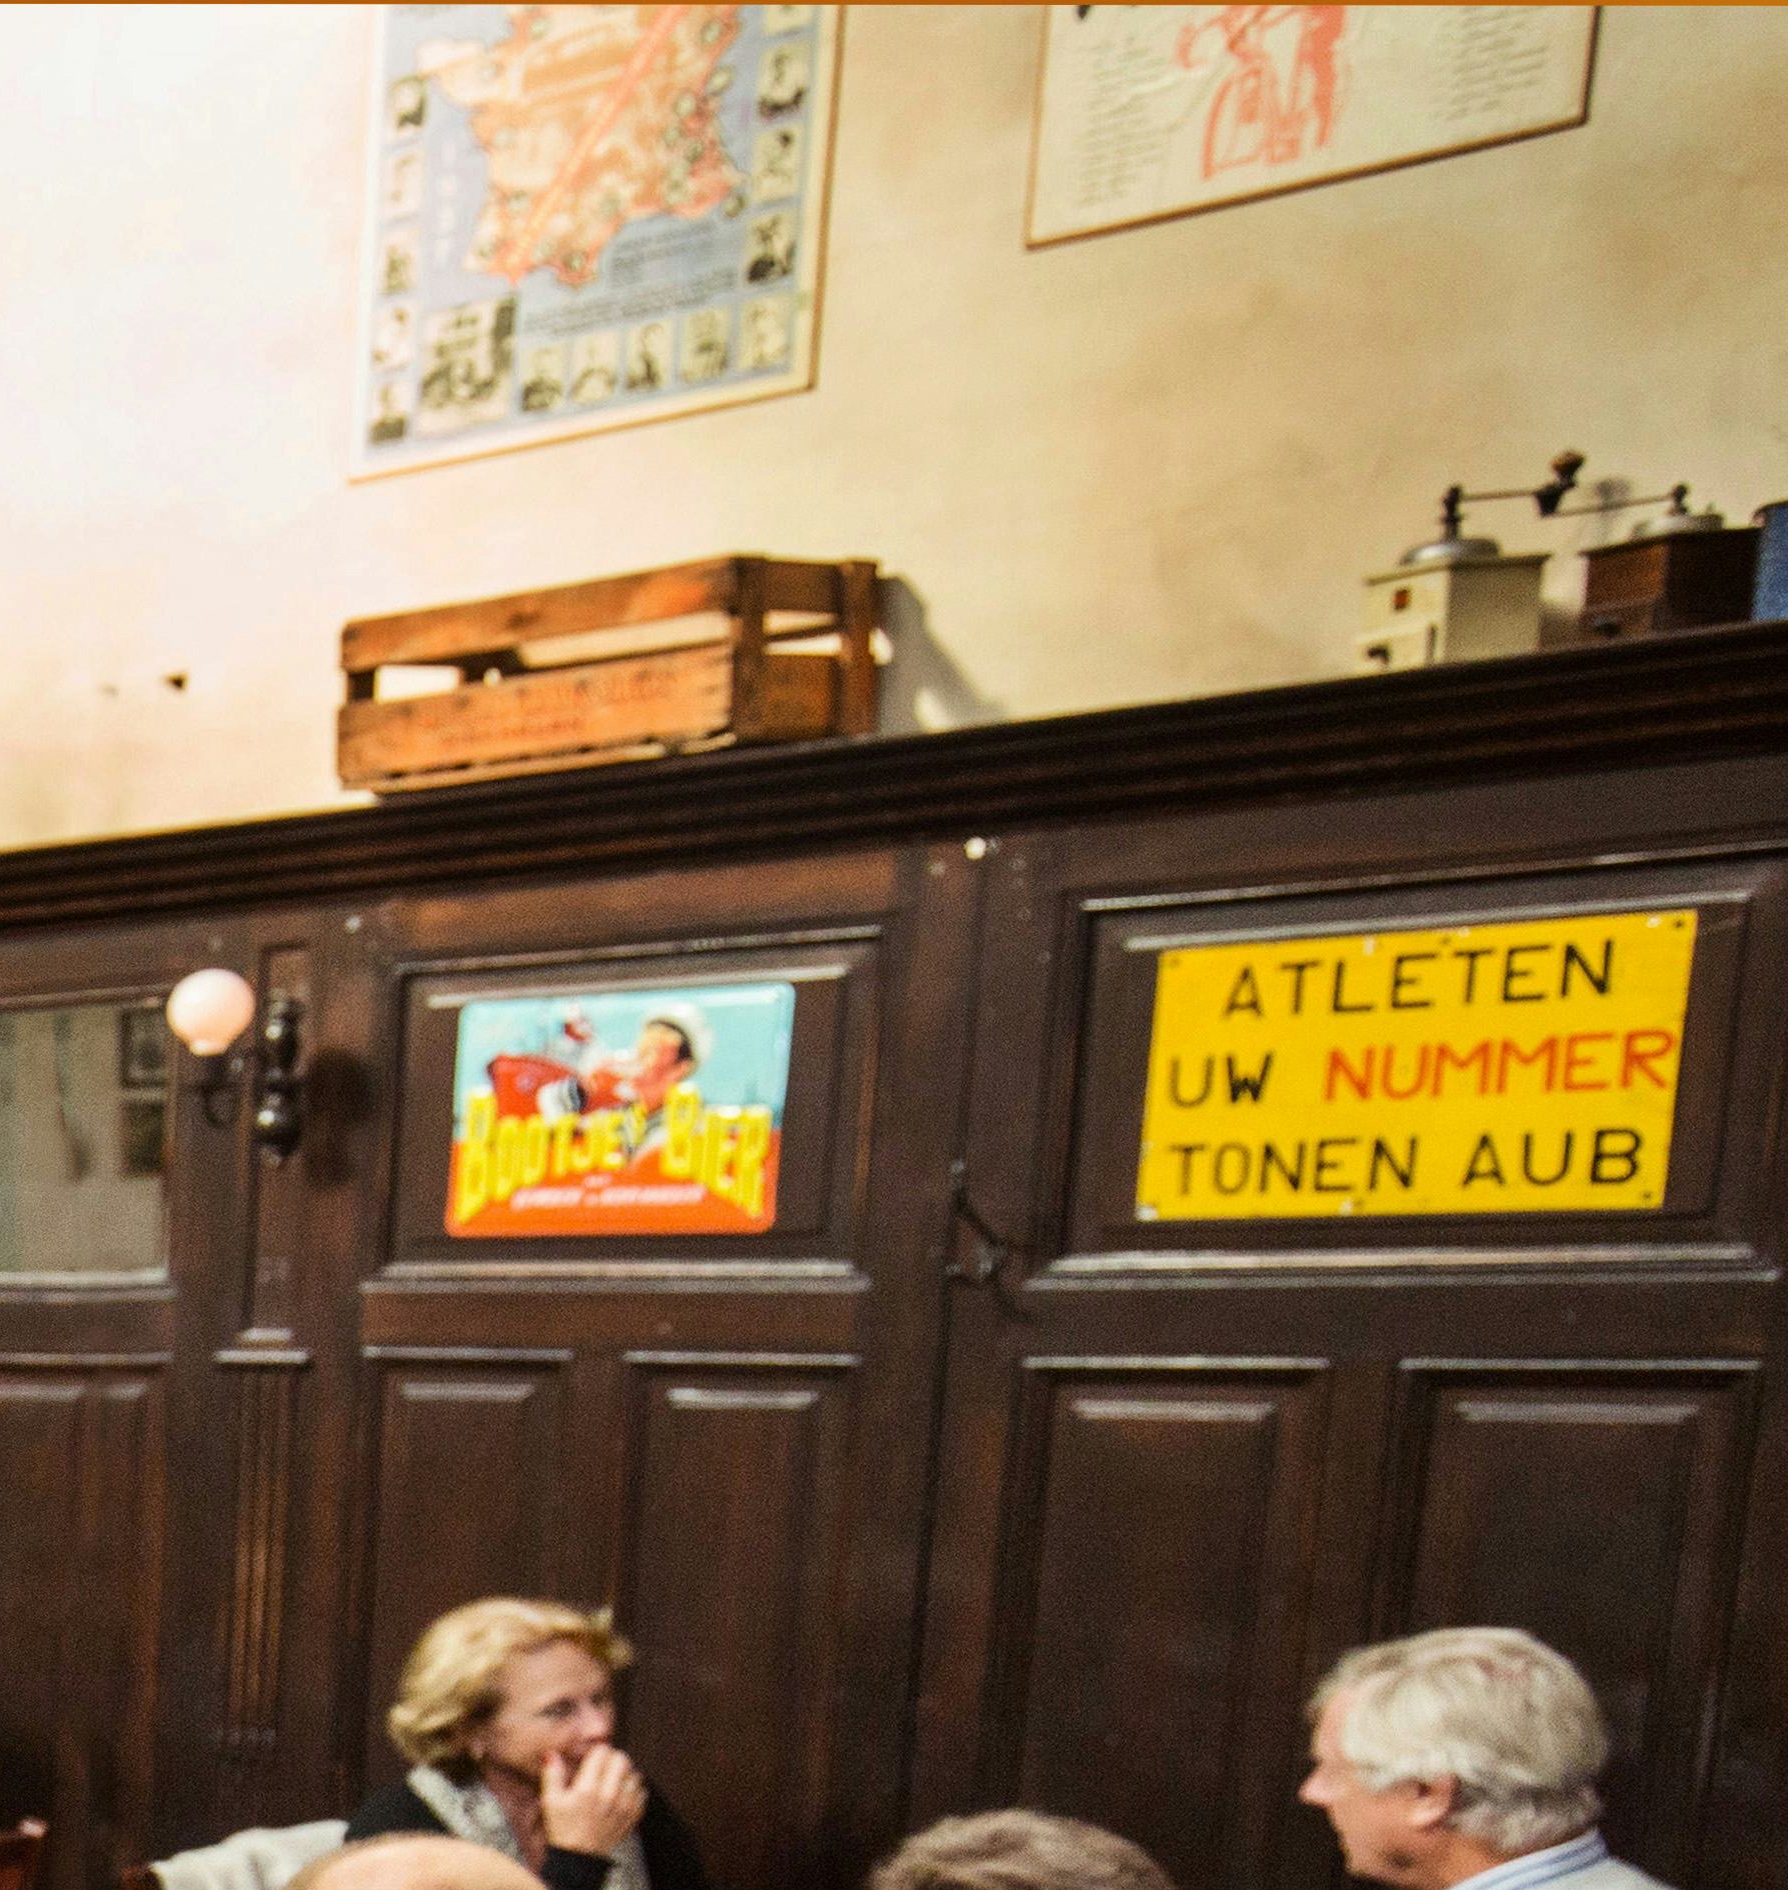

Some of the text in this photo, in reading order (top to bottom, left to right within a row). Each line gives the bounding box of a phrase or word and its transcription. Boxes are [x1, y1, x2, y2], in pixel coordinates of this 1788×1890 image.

[1221, 938, 1615, 1018] ATLETEN
[1167, 1027, 1680, 1108] UW NUMMER
[659, 1081, 775, 1222] BIER
[1169, 1127, 1643, 1197] TONEN AUB
